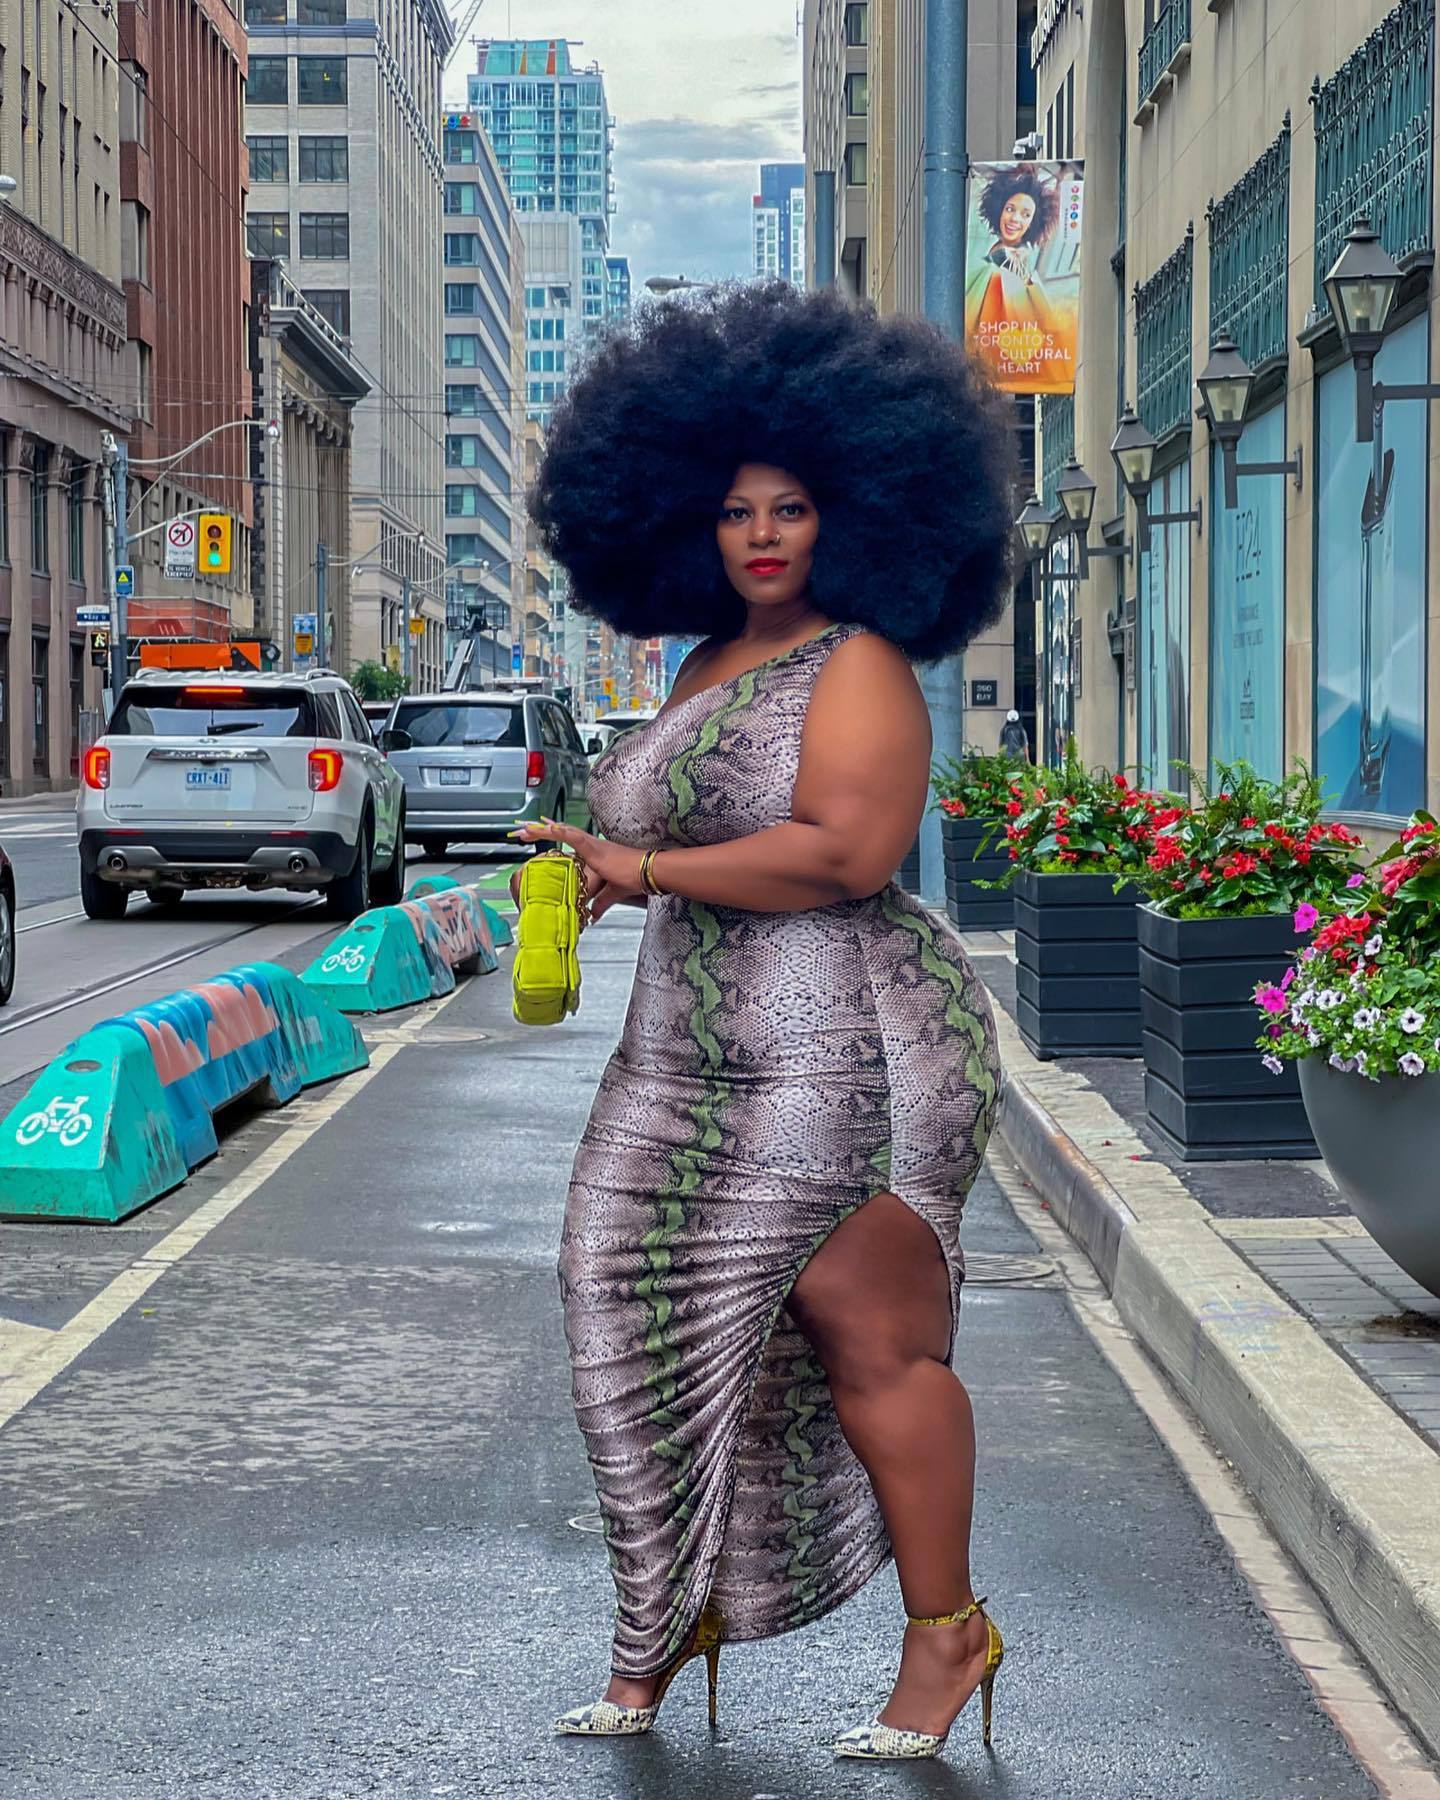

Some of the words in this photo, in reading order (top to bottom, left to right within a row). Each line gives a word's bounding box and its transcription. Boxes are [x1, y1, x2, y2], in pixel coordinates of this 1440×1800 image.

[980, 321, 1019, 333] SHOP
[1023, 320, 1038, 332] IN
[973, 334, 1054, 347] TORONTO'S
[1000, 348, 1071, 360] CULTURAL
[997, 361, 1041, 374] HEART
